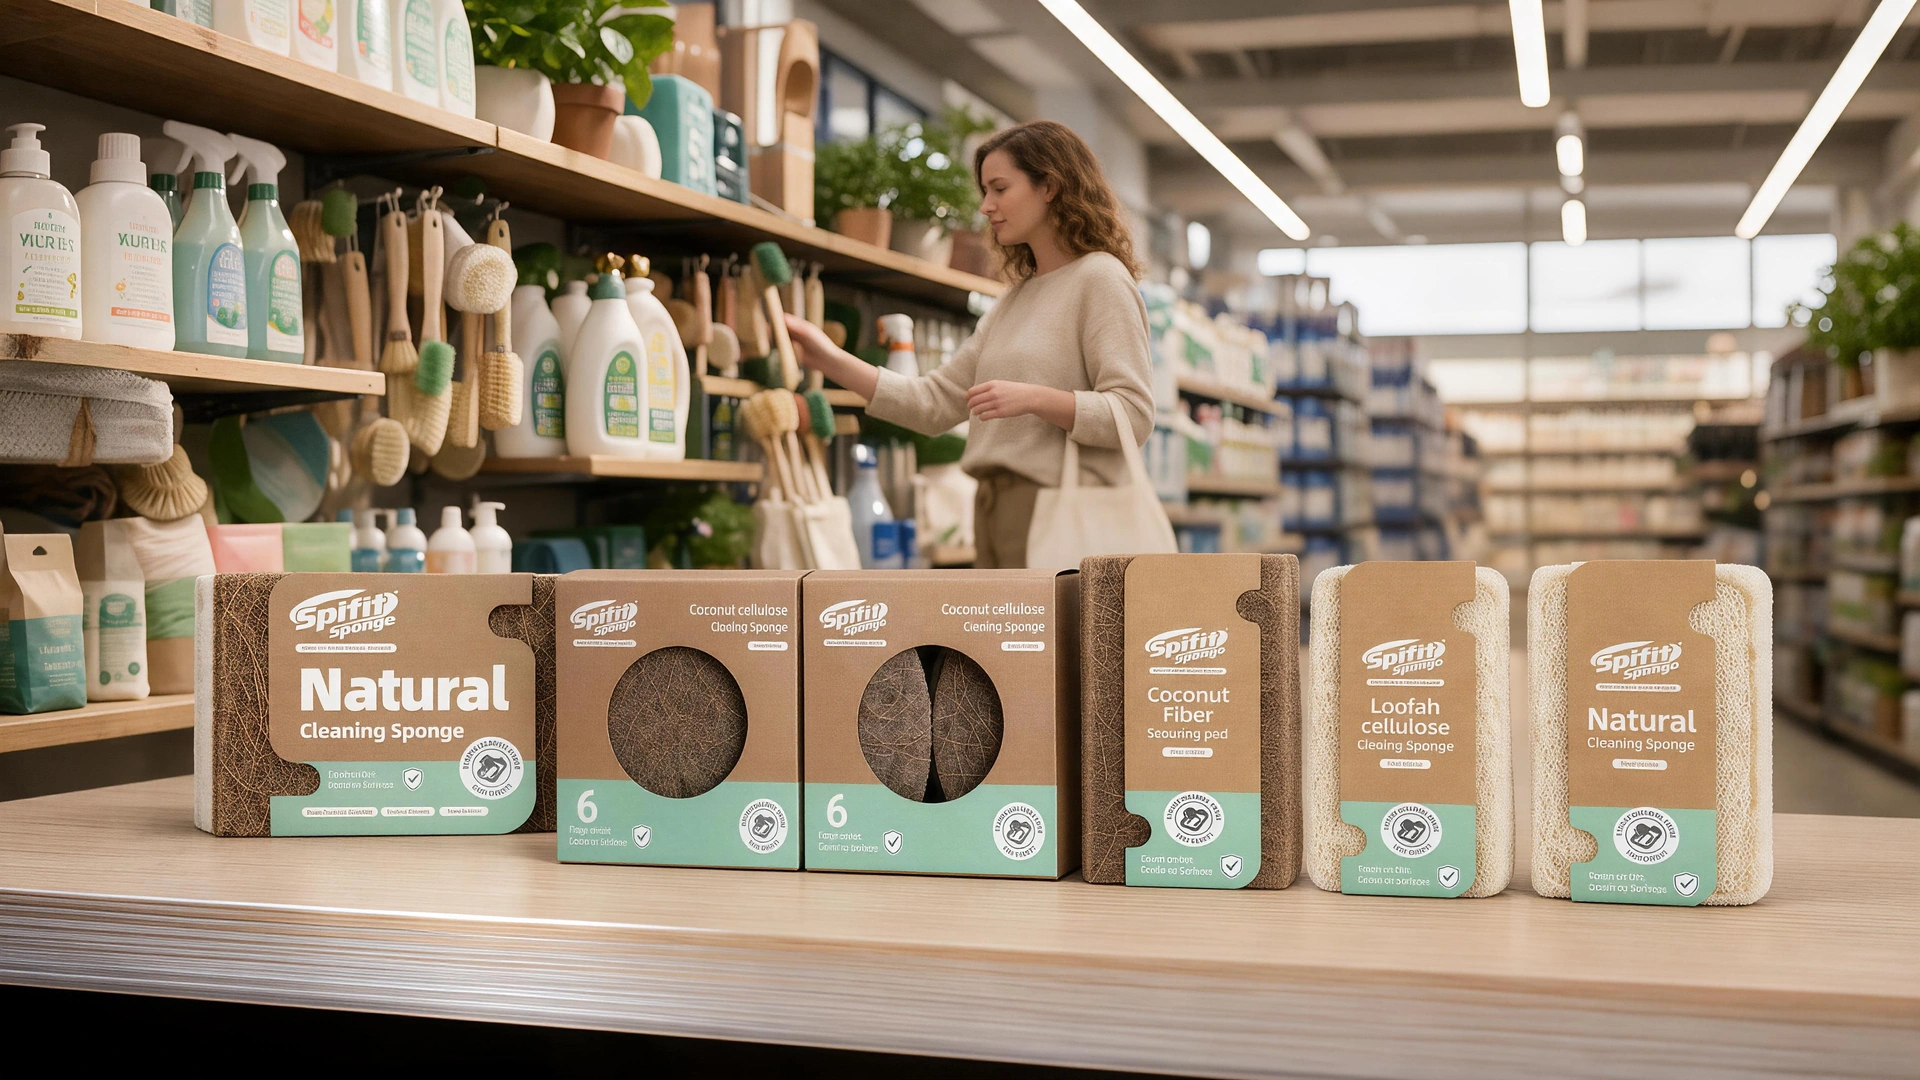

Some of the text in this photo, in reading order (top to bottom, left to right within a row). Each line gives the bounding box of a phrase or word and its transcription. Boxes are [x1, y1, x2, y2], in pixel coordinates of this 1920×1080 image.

[295, 591, 389, 632] Spifit
[689, 603, 736, 616] Coconut
[941, 602, 1045, 615] Coconut cellulose
[750, 621, 788, 634] Sponge
[1005, 621, 1045, 635] Sponge
[300, 664, 510, 712] Natural
[1147, 687, 1230, 703] Coconut
[1163, 705, 1214, 723] Fiber
[1371, 697, 1440, 715] Loofah
[1361, 718, 1450, 735] cellulose
[1588, 707, 1697, 733] Natural
[300, 721, 465, 743] Cleaning Sponge
[1406, 740, 1455, 754] Sponge
[1587, 736, 1695, 753] Cleaning Sponge
[577, 789, 598, 823] 6
[826, 793, 848, 828] 6
